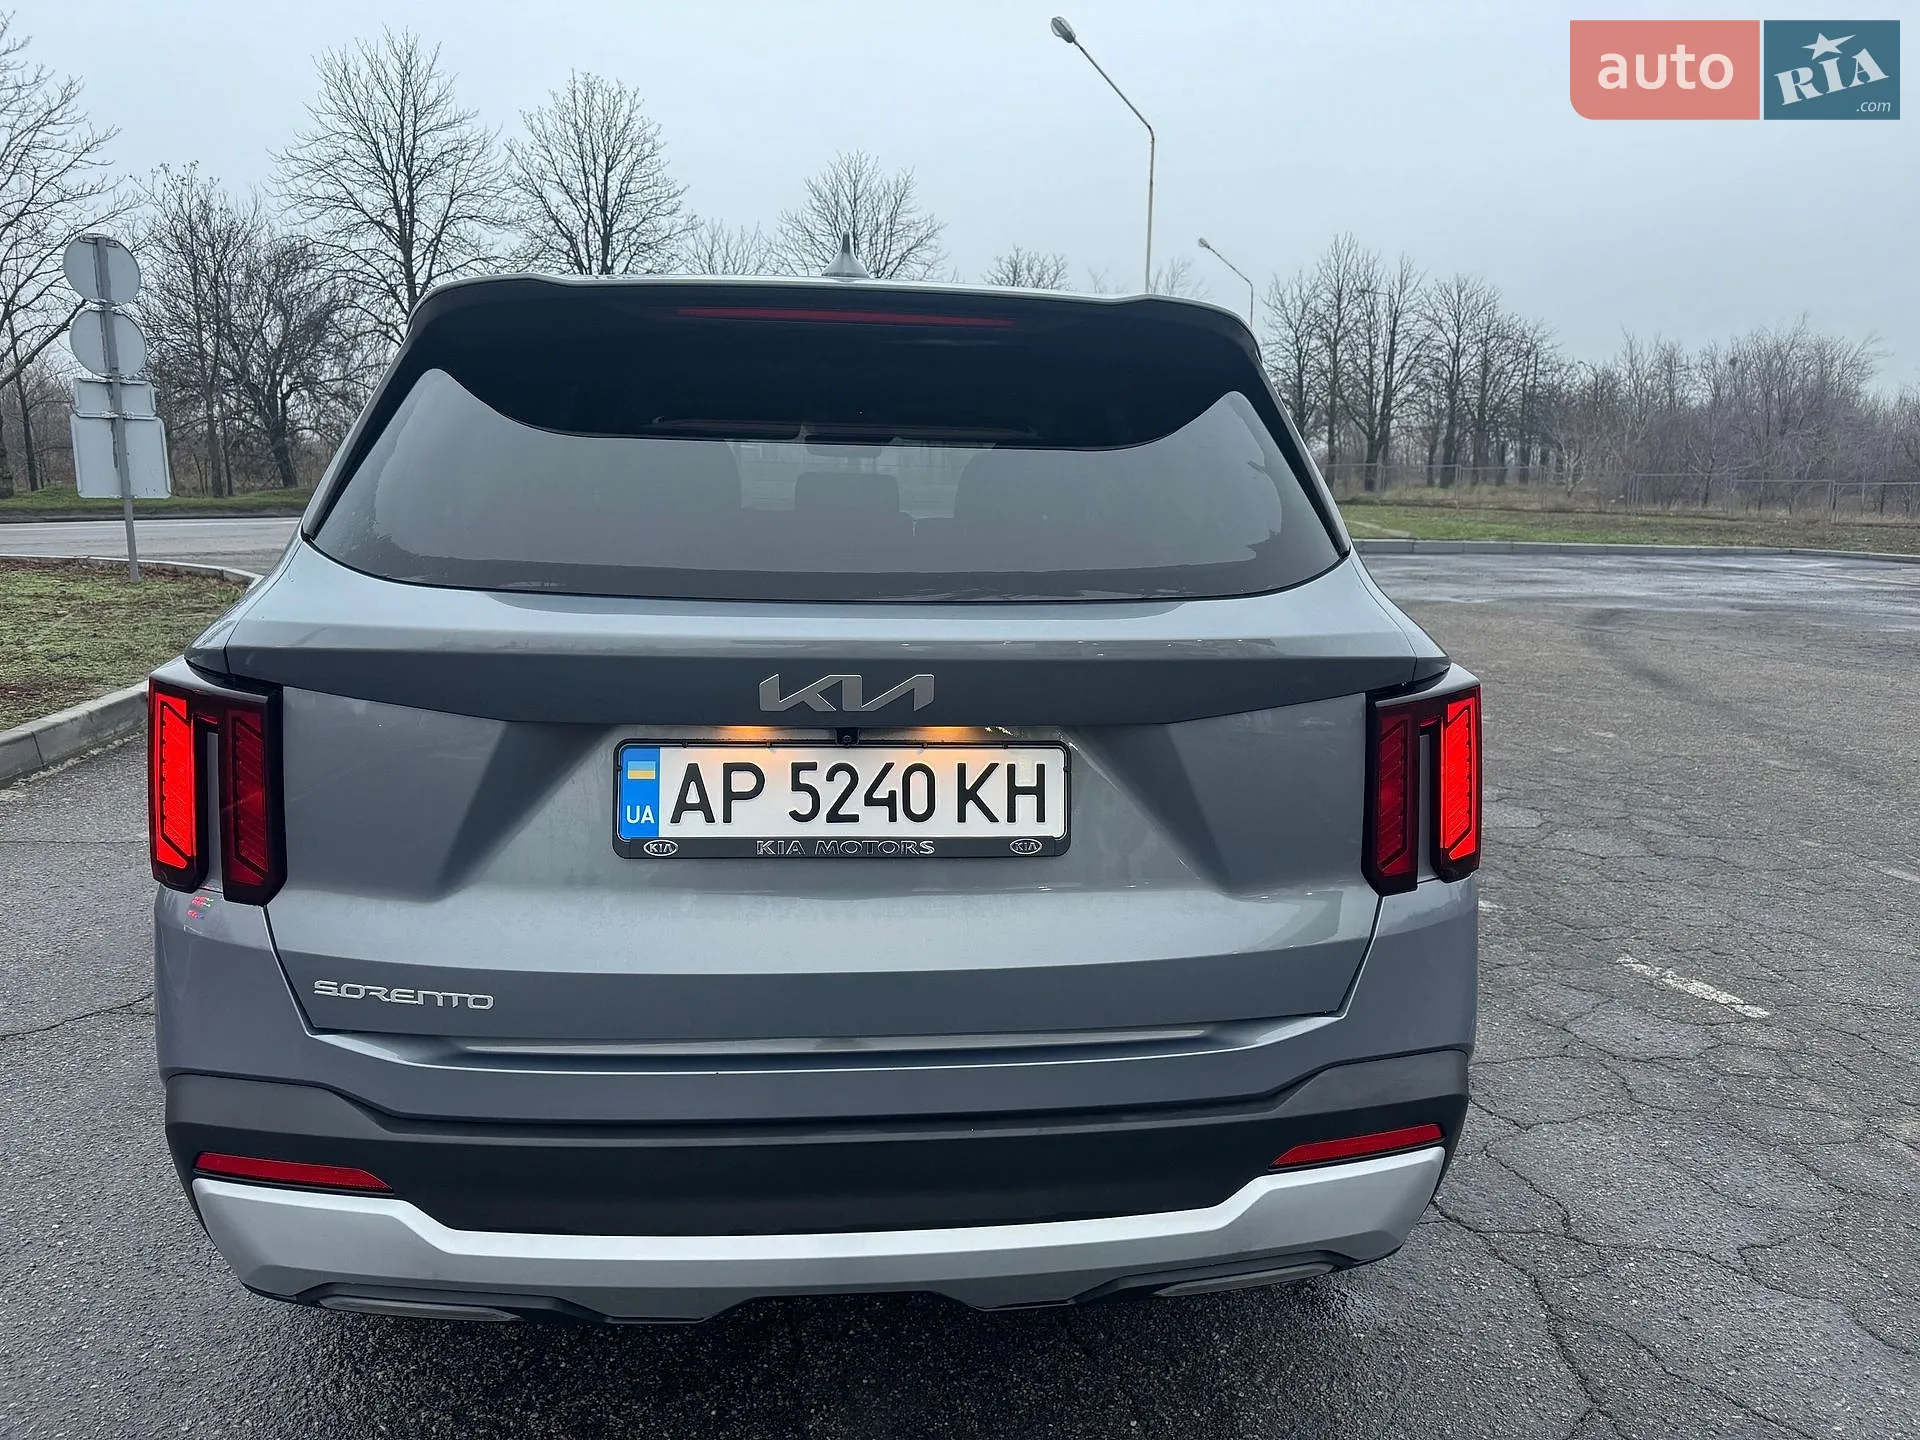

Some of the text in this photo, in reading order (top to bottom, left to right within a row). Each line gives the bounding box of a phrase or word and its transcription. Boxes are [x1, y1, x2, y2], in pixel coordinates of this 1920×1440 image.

[670, 761, 1046, 825] AP 5240 KH
[626, 805, 655, 825] UA
[648, 842, 674, 854] KIA
[755, 839, 936, 856] KIA MOTORS
[1014, 840, 1039, 852] KIA
[313, 979, 495, 1010] SORENTO
